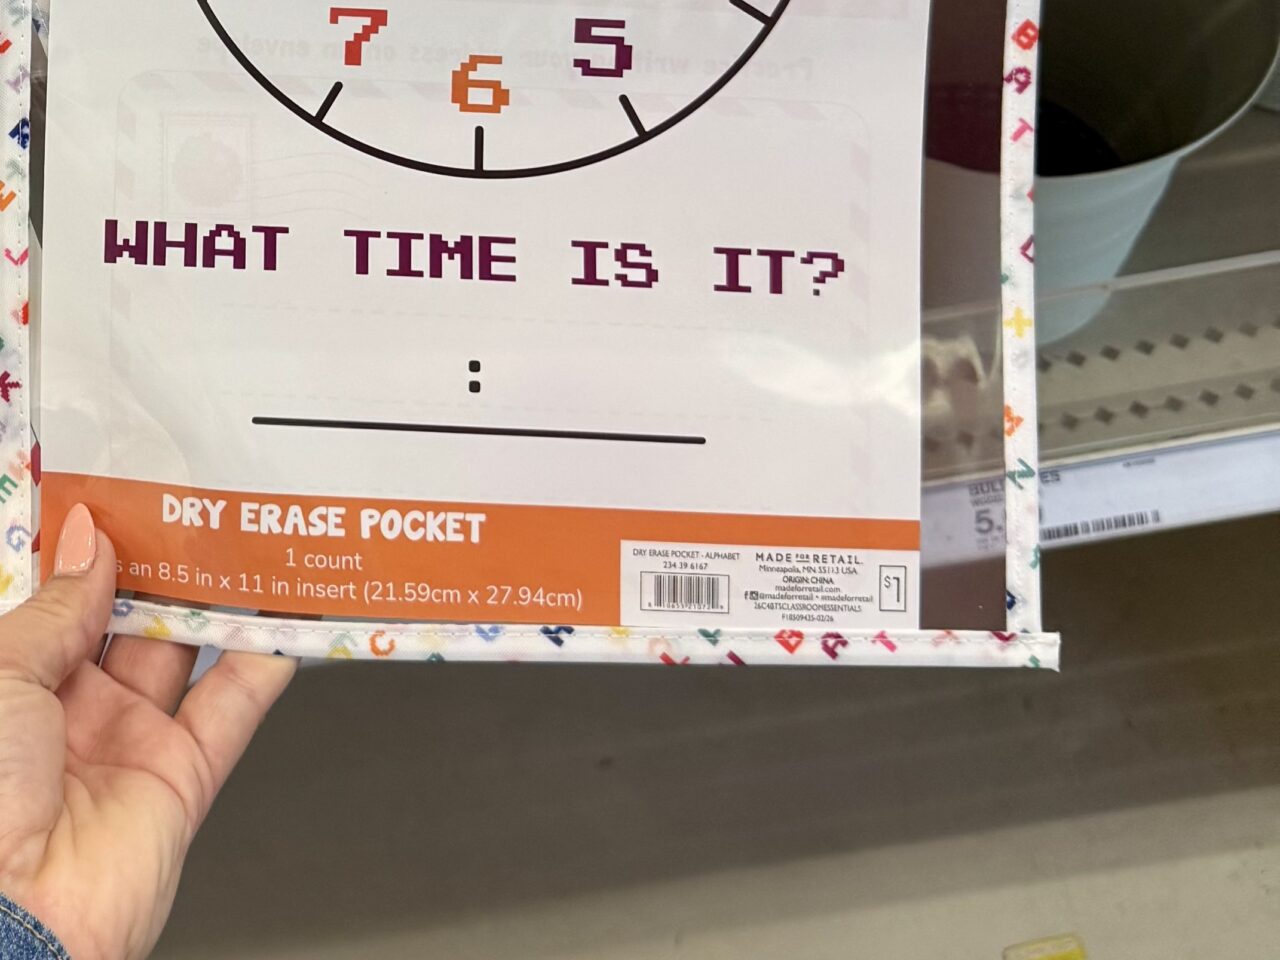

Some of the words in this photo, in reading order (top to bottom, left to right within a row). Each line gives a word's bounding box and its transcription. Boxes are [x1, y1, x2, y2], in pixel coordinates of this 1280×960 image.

[329, 7, 388, 65] 7
[574, 17, 633, 77] 5
[451, 54, 510, 113] 6
[103, 219, 289, 272] WHAT
[344, 228, 517, 282] TIME
[571, 240, 658, 291] IS
[713, 247, 845, 294] IT?
[162, 493, 226, 529] DRY
[240, 502, 346, 536] ERASE
[361, 509, 485, 543] POCKET
[285, 549, 295, 566] 1
[304, 551, 362, 570] count
[633, 548, 647, 556] DRY
[705, 552, 740, 560] ALPHABET
[690, 562, 708, 570] 6167
[756, 553, 792, 562] MADE
[128, 562, 152, 578] an
[158, 563, 189, 583] 8.5
[196, 568, 213, 587] in
[219, 576, 229, 590] x
[238, 573, 263, 593] 11
[271, 578, 289, 596] in
[297, 579, 356, 600] insert
[363, 580, 461, 605] (21.59cm
[468, 590, 479, 604] x
[486, 586, 583, 611] 27.94cm)
